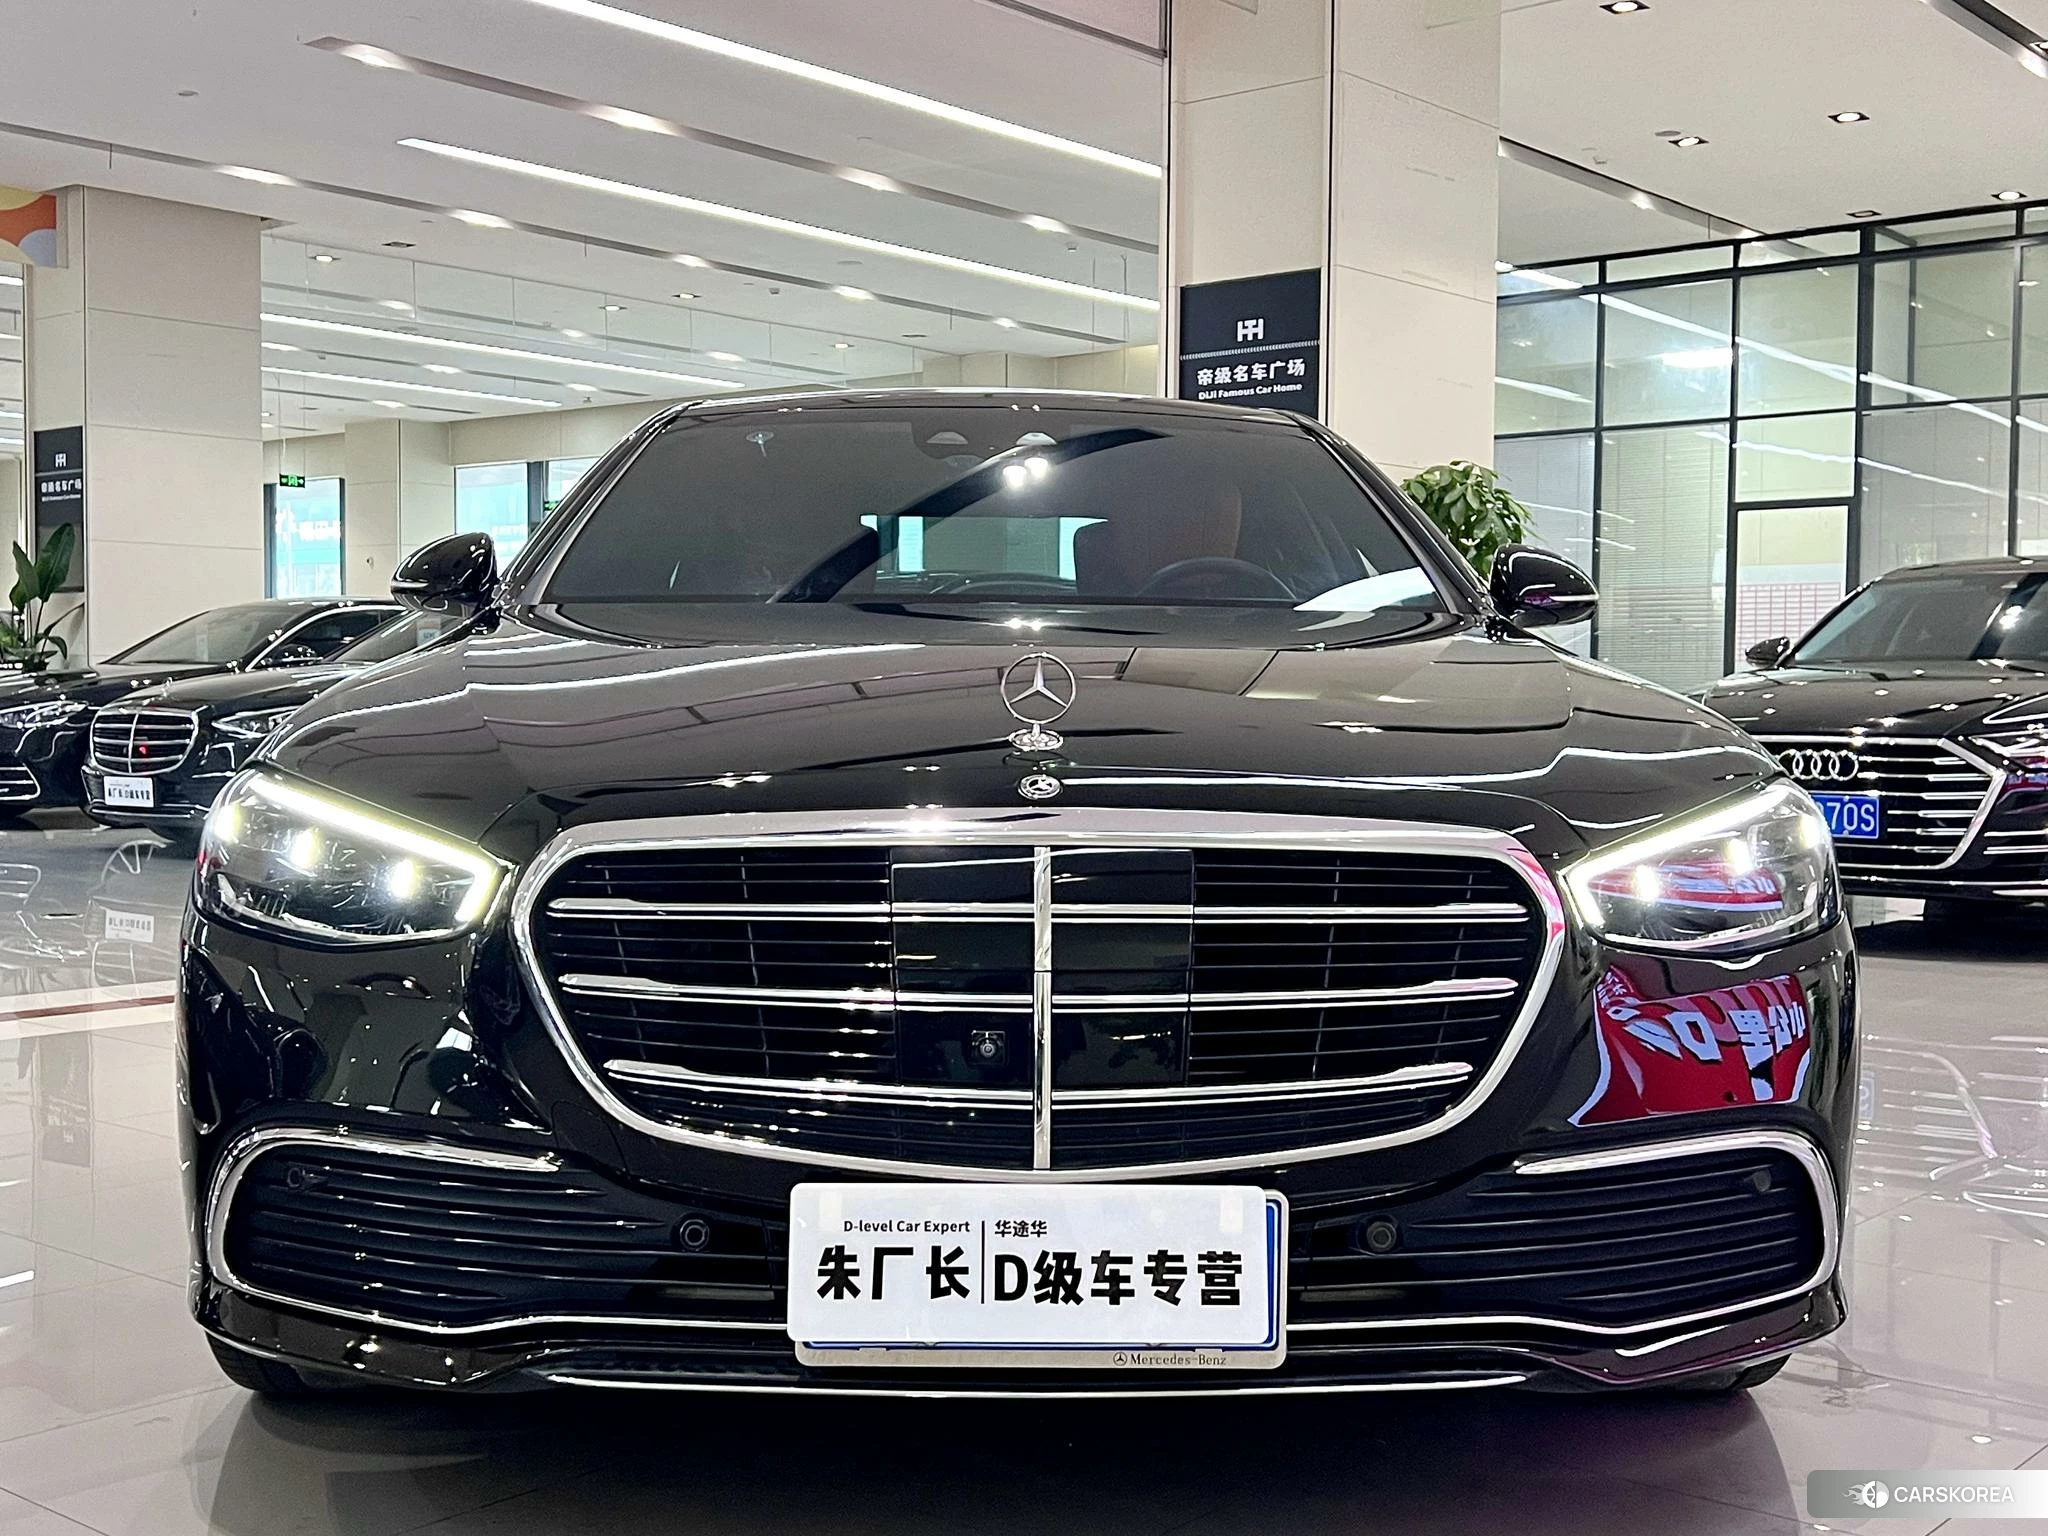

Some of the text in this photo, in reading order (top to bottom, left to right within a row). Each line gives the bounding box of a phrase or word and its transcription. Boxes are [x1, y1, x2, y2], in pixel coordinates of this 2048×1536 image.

[1196, 358, 1305, 386] 帝级名车广场
[1218, 387, 1254, 399] Famous
[1255, 385, 1272, 394] Car
[1273, 383, 1303, 393] Home
[1815, 801, 1875, 832] 70S
[843, 1219, 971, 1235] D-level Car Expert
[994, 1219, 1048, 1238] 华途华
[816, 1244, 971, 1300] 朱厂长
[994, 1249, 1243, 1307] D级车专营
[1130, 1353, 1227, 1366] Mercedes-Benz
